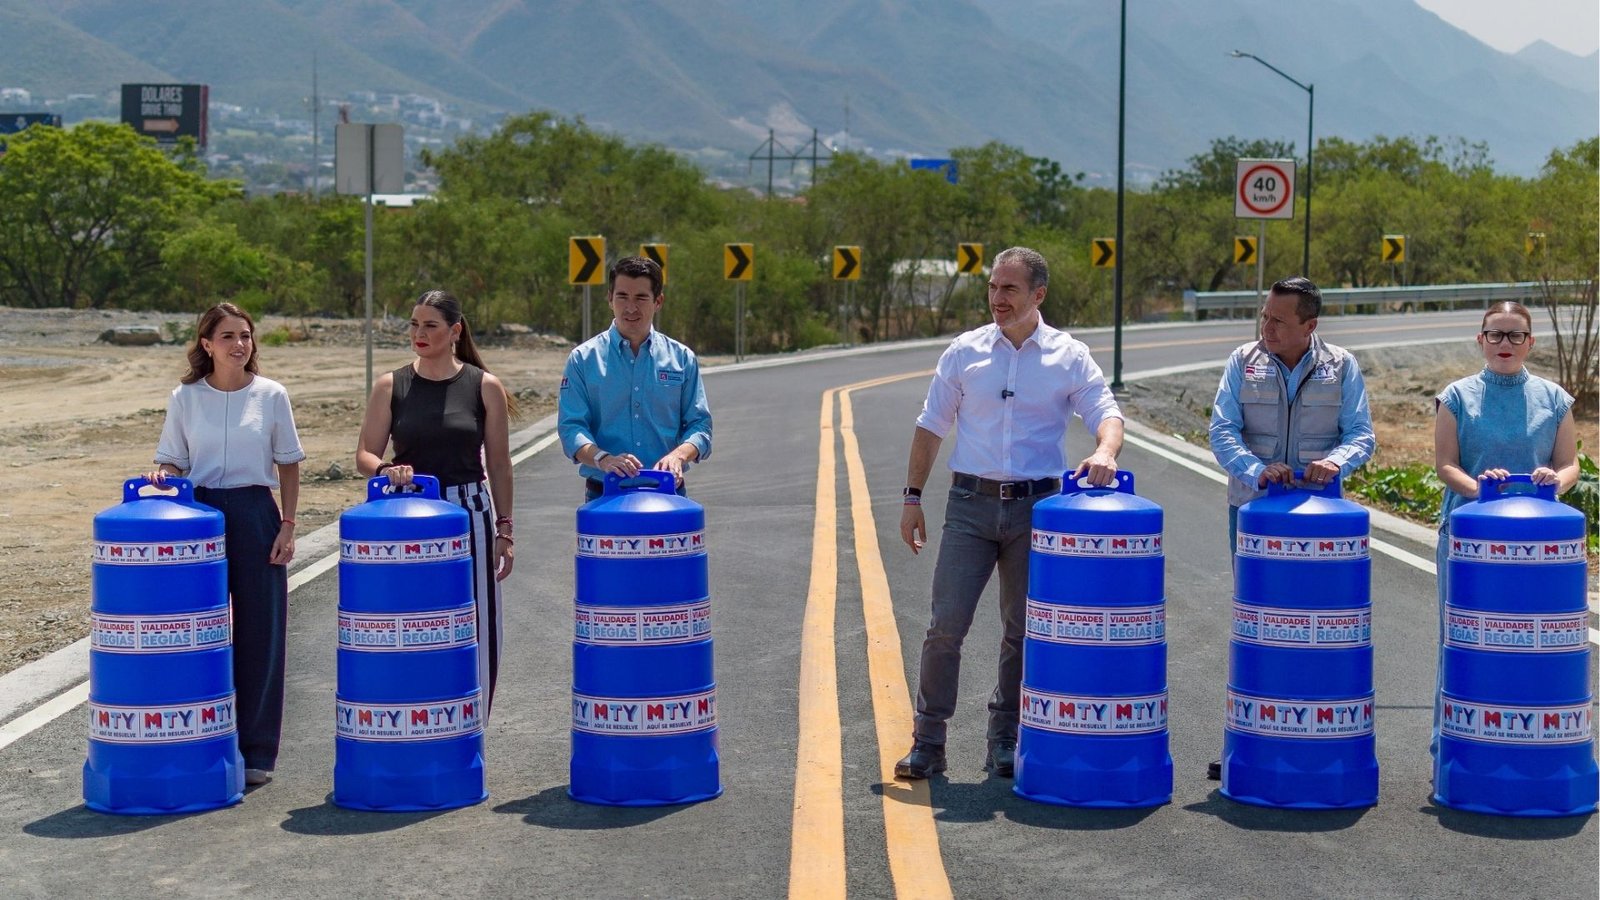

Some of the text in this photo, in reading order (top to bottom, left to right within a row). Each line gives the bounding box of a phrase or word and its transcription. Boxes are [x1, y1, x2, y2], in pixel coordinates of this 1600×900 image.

[141, 86, 183, 102] DOLARES
[1253, 177, 1276, 192] 40
[1253, 193, 1277, 203] km/h
[405, 542, 445, 554] MTY
[600, 539, 639, 550] MTY
[649, 537, 688, 549] MTY
[1062, 537, 1104, 549] MTY
[1113, 539, 1151, 548] MTY
[1268, 541, 1311, 551] MTY
[1320, 540, 1356, 552] MTY
[1454, 542, 1481, 553] MTY
[1545, 543, 1577, 555] MTY
[111, 546, 148, 557] MTY
[158, 544, 199, 556] MTY
[358, 545, 396, 555] MTY
[1491, 545, 1536, 556] MTY
[403, 619, 449, 628] VIALIDADES
[643, 614, 688, 622] VIALIDADES
[1058, 614, 1103, 622] VIALIDADES
[1110, 615, 1151, 623] VIALIDADES
[1264, 617, 1310, 625] VIALIDADES
[99, 622, 134, 630] VIALIDADES
[141, 622, 190, 630] VIALIDADES
[644, 625, 688, 637] REGIAS
[1058, 625, 1103, 637] REGIAS
[1110, 627, 1151, 637] REGIAS
[403, 631, 449, 643] REGIAS
[594, 628, 636, 637] REGIAS
[1263, 628, 1310, 639] REGIAS
[1317, 629, 1359, 640] REGIAS
[1541, 632, 1579, 644] REGIAS
[100, 635, 134, 645] REGIAS
[141, 634, 190, 645] REGIAS
[355, 634, 396, 644] REGIAS
[1485, 634, 1534, 644] REGIAS
[574, 699, 588, 719] TY
[1023, 694, 1050, 716] MTY
[1117, 701, 1156, 721] MTY
[202, 702, 232, 724] MTY
[411, 706, 456, 726] MTY
[594, 703, 638, 721] MTY
[647, 702, 692, 721] MTY
[1059, 702, 1107, 721] MTY
[1261, 704, 1308, 724] MTY
[1318, 705, 1359, 724] MTY
[1445, 704, 1476, 725] MTY
[99, 711, 135, 729] MTY
[145, 710, 194, 729] MTY
[359, 709, 400, 727] MTY
[1485, 710, 1535, 730] MTY
[1544, 711, 1582, 730] MTY
